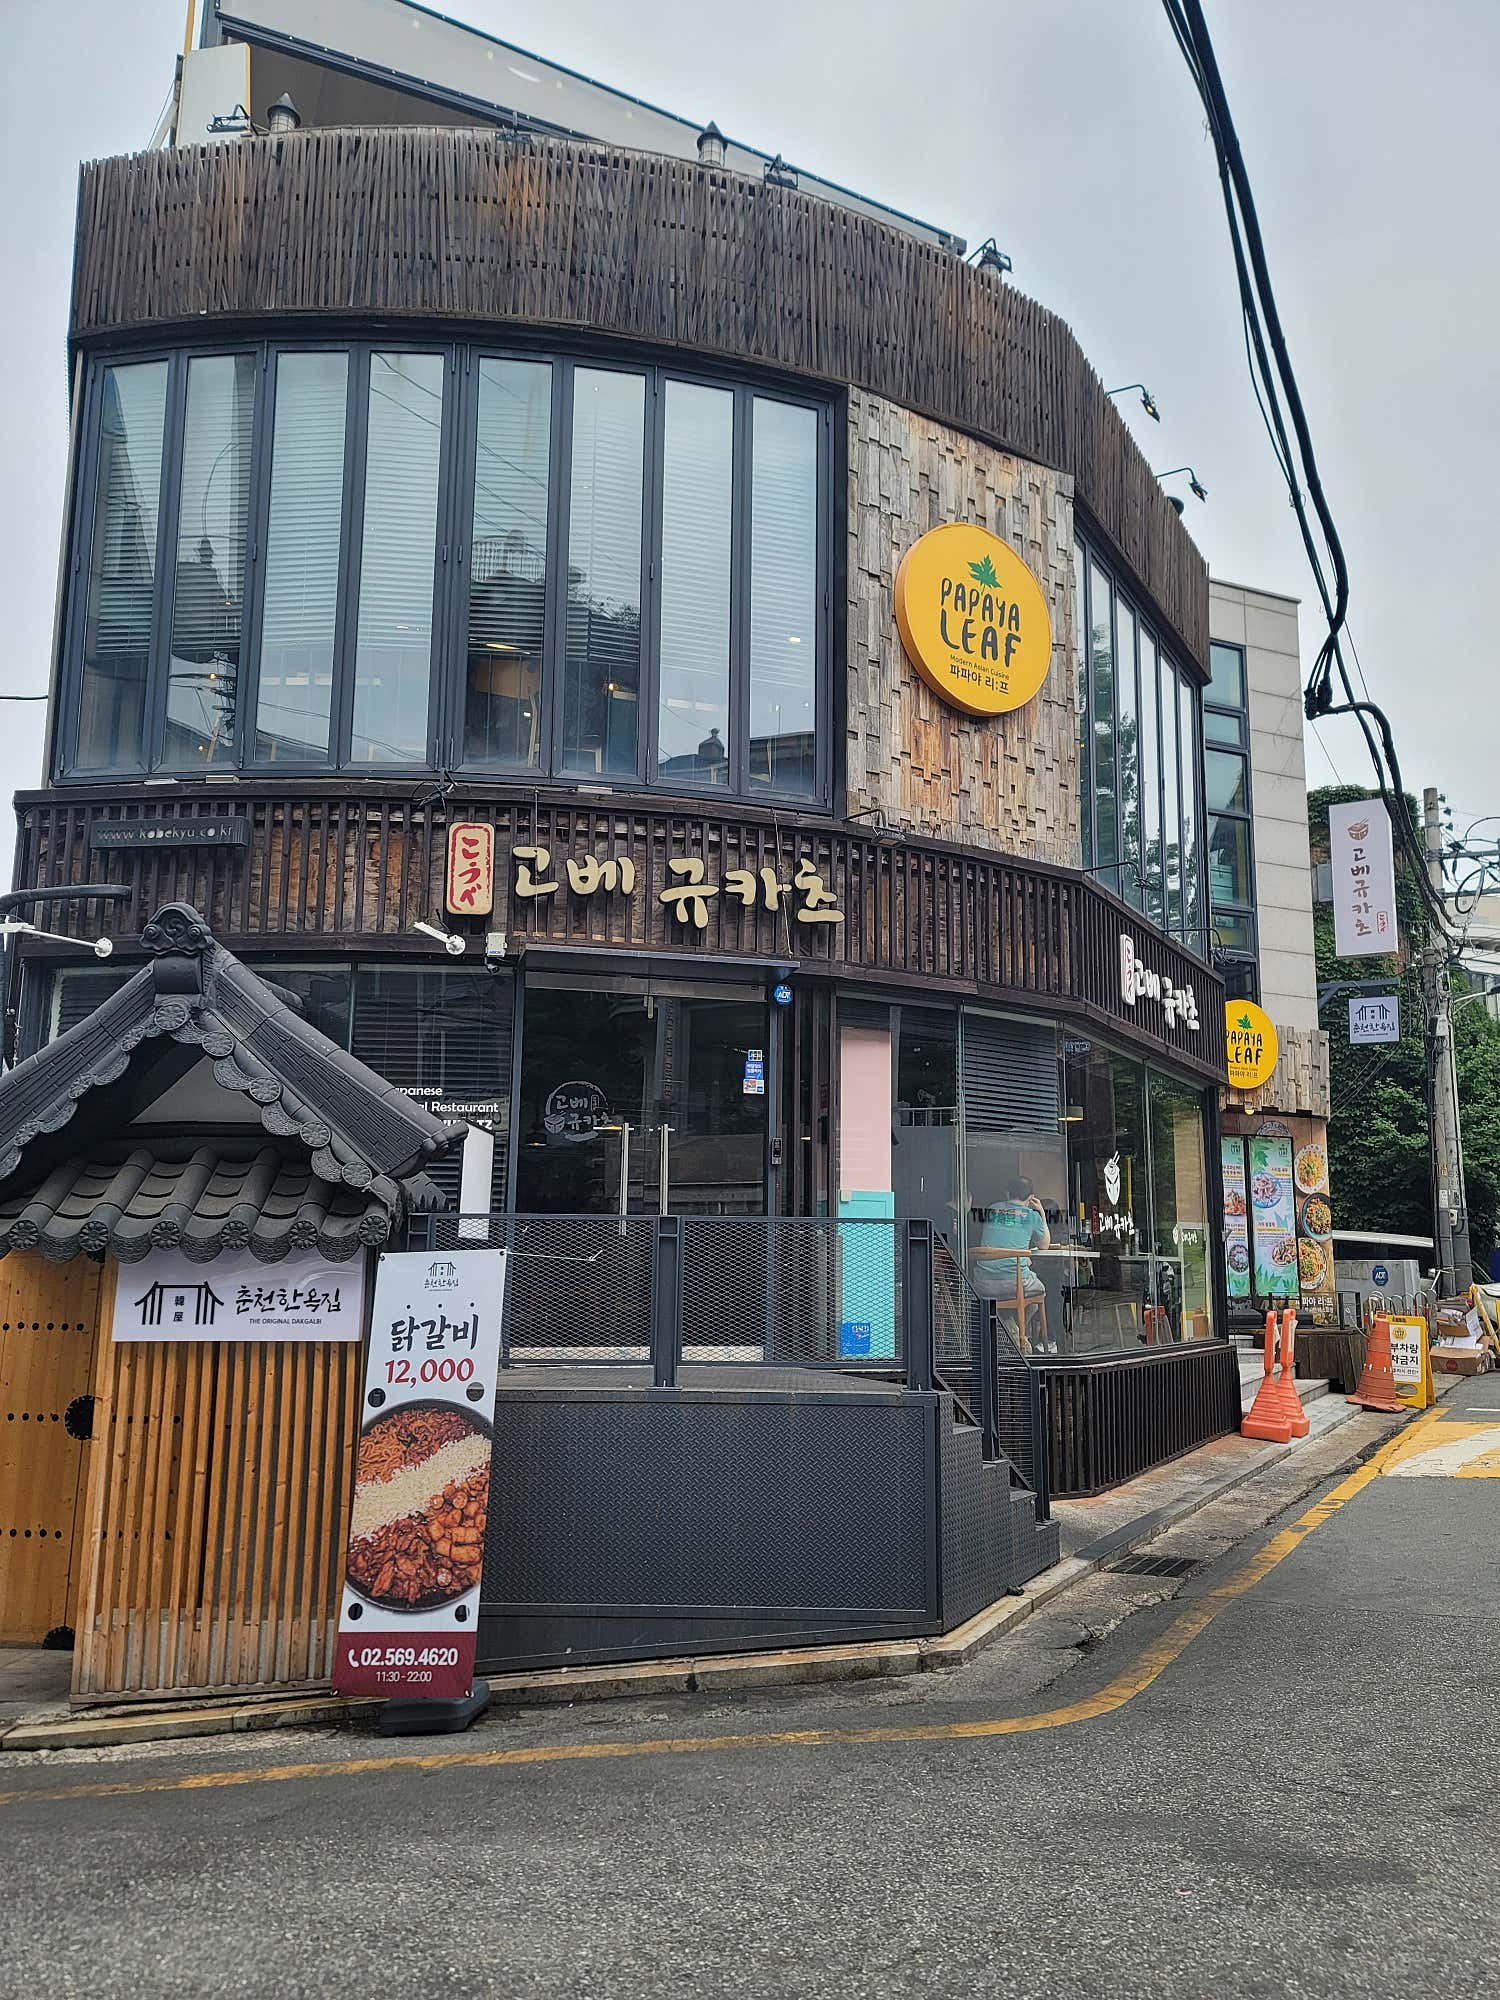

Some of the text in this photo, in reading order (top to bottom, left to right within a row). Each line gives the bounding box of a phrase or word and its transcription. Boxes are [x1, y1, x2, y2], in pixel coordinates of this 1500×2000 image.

[940, 577, 1021, 632] PAPAYA
[940, 607, 1021, 668] LEAF
[950, 654, 973, 668] Modern
[973, 663, 990, 674] Asian
[949, 663, 981, 687] 파파야
[97, 823, 233, 842] www.kobekyu.co.kr
[457, 836, 483, 907] こうべ
[512, 846, 846, 929] 고베 규카츠
[395, 1087, 443, 1096] panese
[431, 1101, 499, 1113] Restaurant
[556, 1095, 589, 1109] 고베
[235, 1285, 342, 1315] 춘천한옥집
[390, 1313, 479, 1353] 닭갈비
[1391, 1343, 1419, 1354] 부차량
[1391, 1354, 1419, 1366] 차금지
[385, 1358, 475, 1388] 12,000
[360, 1647, 459, 1667] 02.569.4620
[375, 1671, 400, 1682] 11:30
[406, 1671, 432, 1682] 22:00
